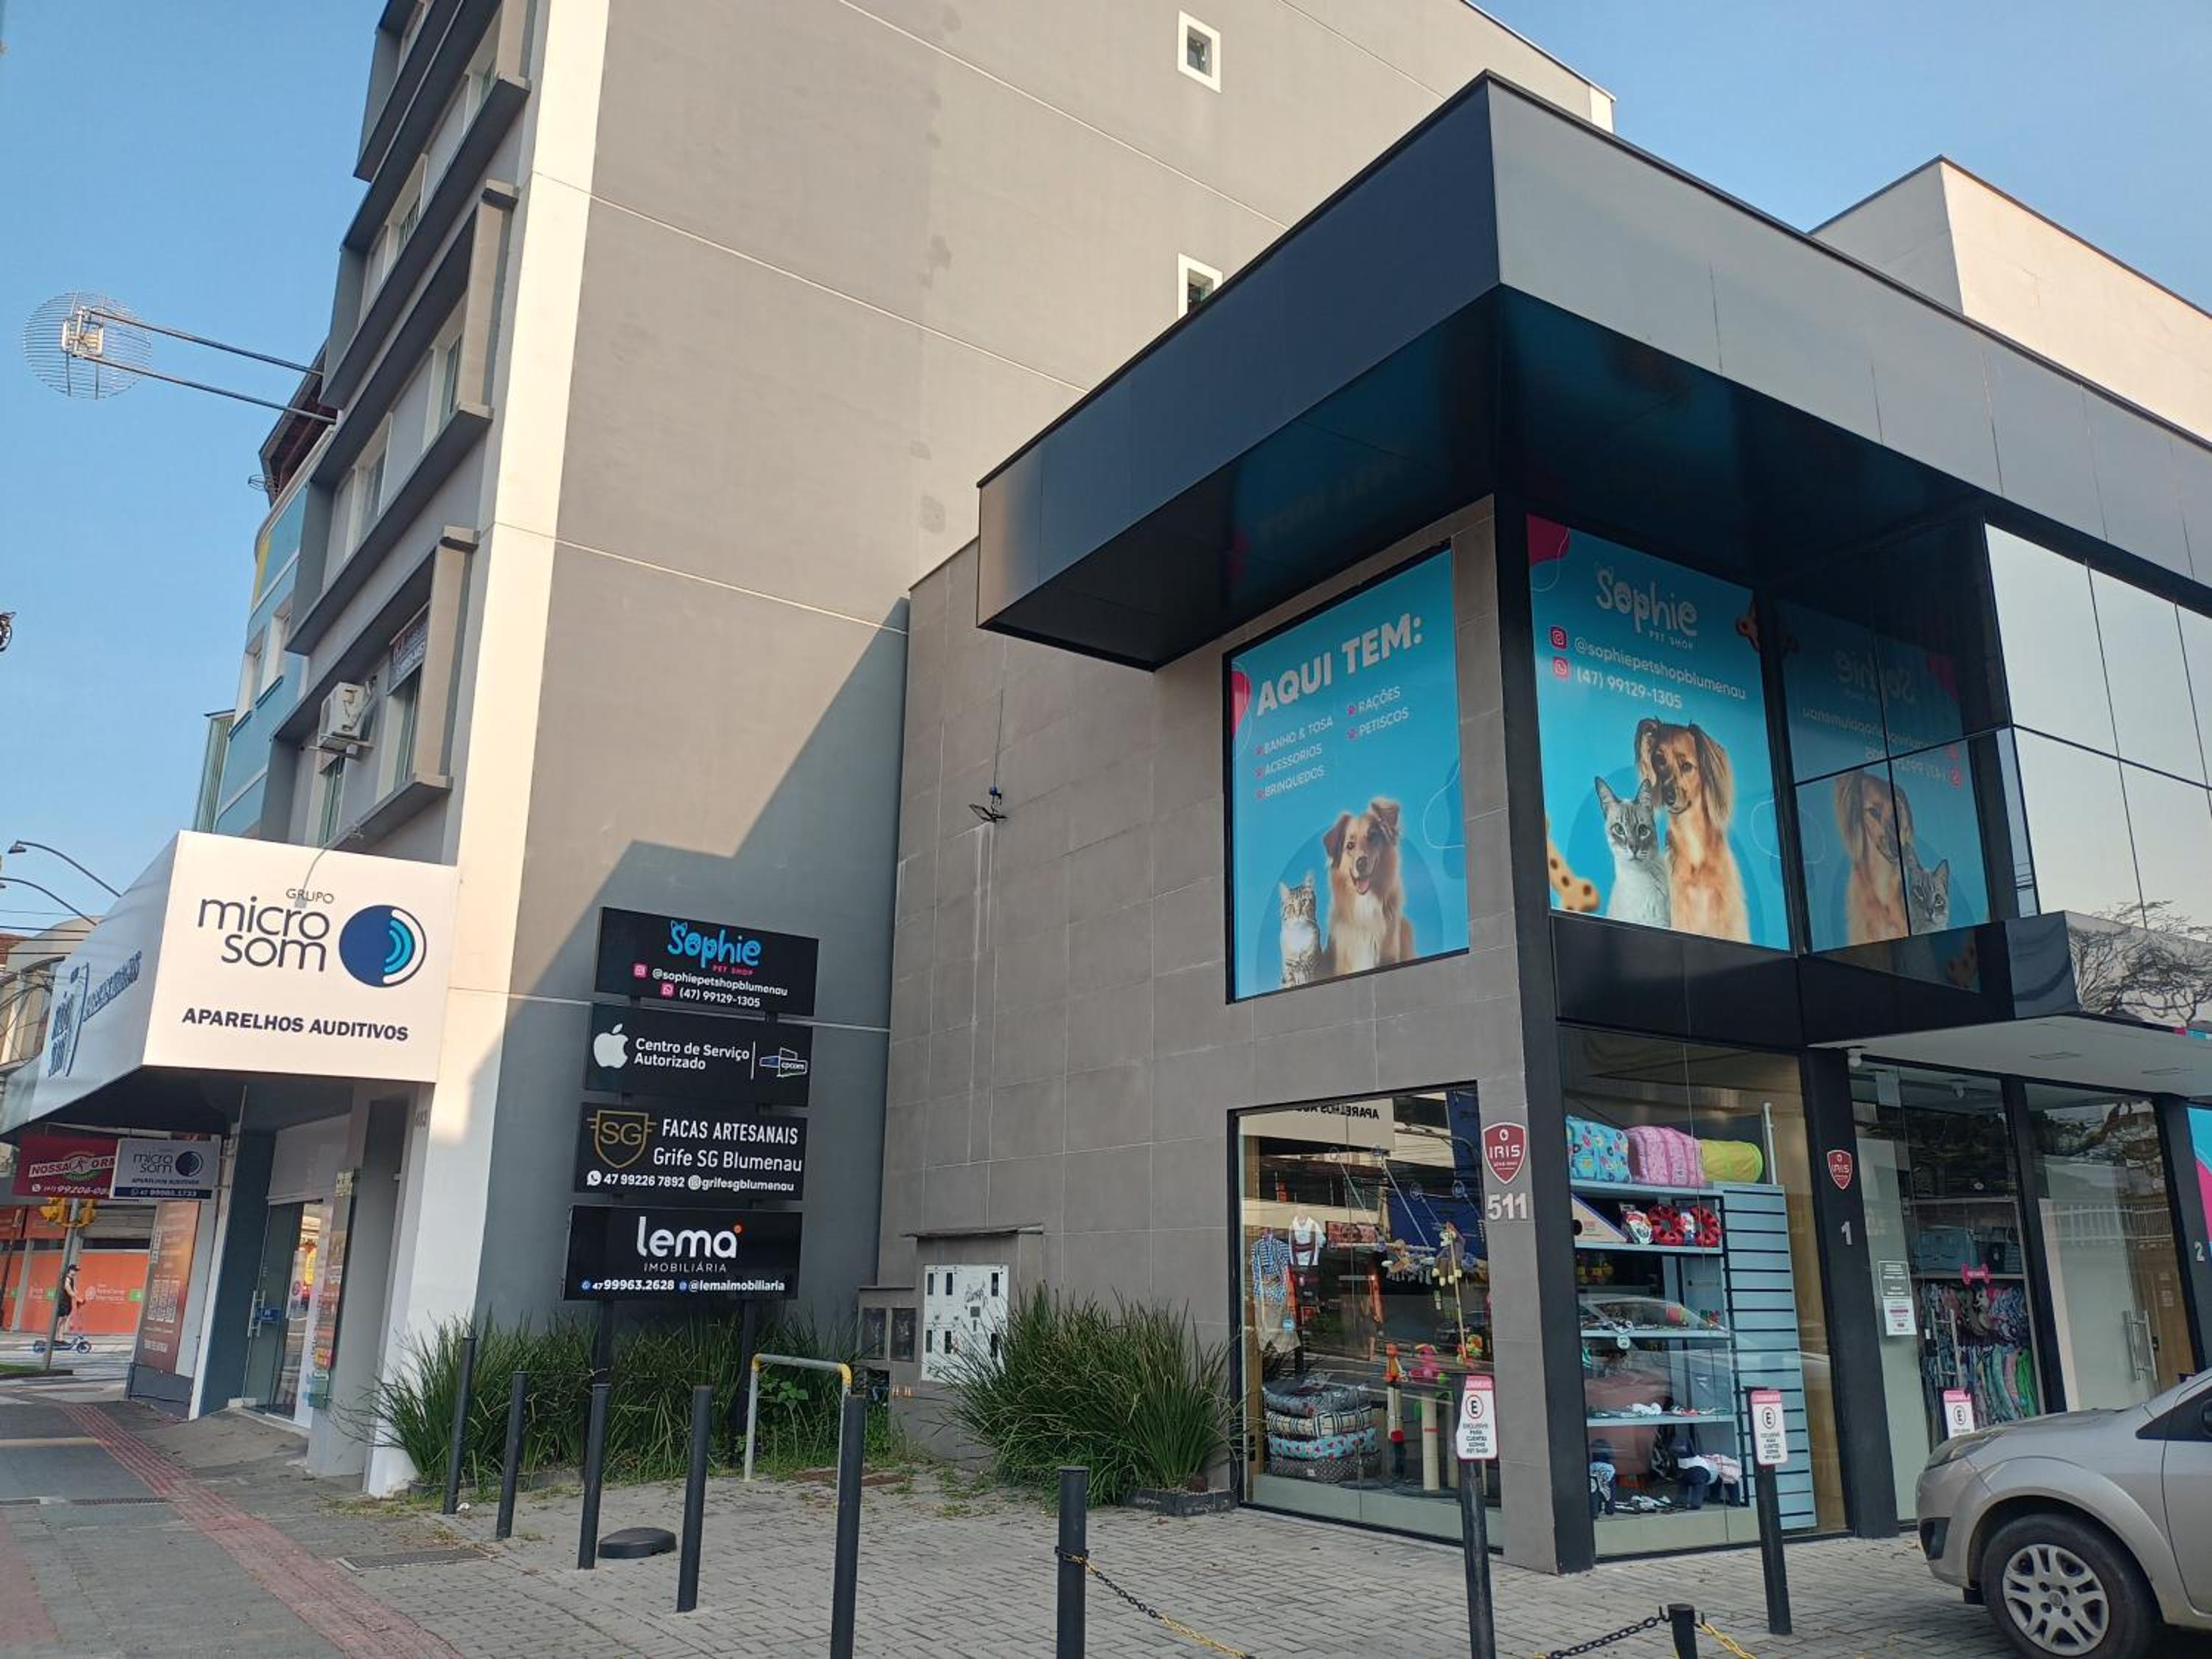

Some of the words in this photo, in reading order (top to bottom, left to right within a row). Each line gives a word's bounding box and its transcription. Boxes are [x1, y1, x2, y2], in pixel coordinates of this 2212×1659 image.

[1596, 565, 1697, 636] Sophie
[1649, 631, 1664, 643] PET
[1257, 653, 1332, 716] AQUI
[1342, 613, 1422, 674] TEM:
[1574, 636, 1745, 700] @sophiepetshopblumenau
[1577, 667, 1604, 689] (47)
[1607, 676, 1683, 709] 99129-1305
[1359, 708, 1409, 736] PETISCOS
[1263, 731, 1295, 755] BANHO
[1298, 725, 1306, 740] &
[1308, 716, 1333, 737] TOSA
[1264, 765, 1326, 798] BRINQUEDOS
[285, 888, 335, 905] GRUPO
[198, 896, 330, 940] micro
[221, 933, 327, 972] som
[667, 920, 762, 968] Sophie
[652, 968, 788, 996] @sophiepetshopblumenau
[712, 964, 728, 973] PET
[731, 967, 755, 976] SHOP
[679, 989, 700, 1001] (47)
[703, 990, 761, 1007] 99129-1305
[182, 1008, 304, 1033] APARELHOS
[309, 1019, 409, 1041] AUDITIVOS
[636, 1037, 681, 1054] Centro
[684, 1041, 700, 1055] de
[703, 1043, 750, 1061] Serviço
[634, 1053, 706, 1070] Autorizado
[600, 1121, 643, 1145] SG
[662, 1119, 708, 1139] FACAS
[712, 1122, 798, 1145] ARTESANAIS
[133, 1151, 173, 1164] micro
[653, 1147, 692, 1166] Grife
[698, 1150, 719, 1167] SG
[723, 1151, 802, 1172] Blumenau
[1489, 1144, 1521, 1158] IRIS
[32, 1163, 69, 1175] NOSSA
[141, 1164, 172, 1173] som
[604, 1173, 618, 1184] 47
[622, 1174, 655, 1186] 99226
[658, 1176, 685, 1188] 7892
[702, 1178, 794, 1192] grifesgblumenau
[1488, 1192, 1527, 1220] 511
[636, 1217, 738, 1259] lema
[1841, 1221, 1852, 1245] 1
[2194, 1241, 2205, 1261] 2
[644, 1262, 727, 1273] IMOBILIÁRIA
[689, 1279, 785, 1293] @lemaimobiliaria
[1470, 1400, 1478, 1414] E
[1765, 1412, 1772, 1425] E
[1956, 1409, 1963, 1422] E
